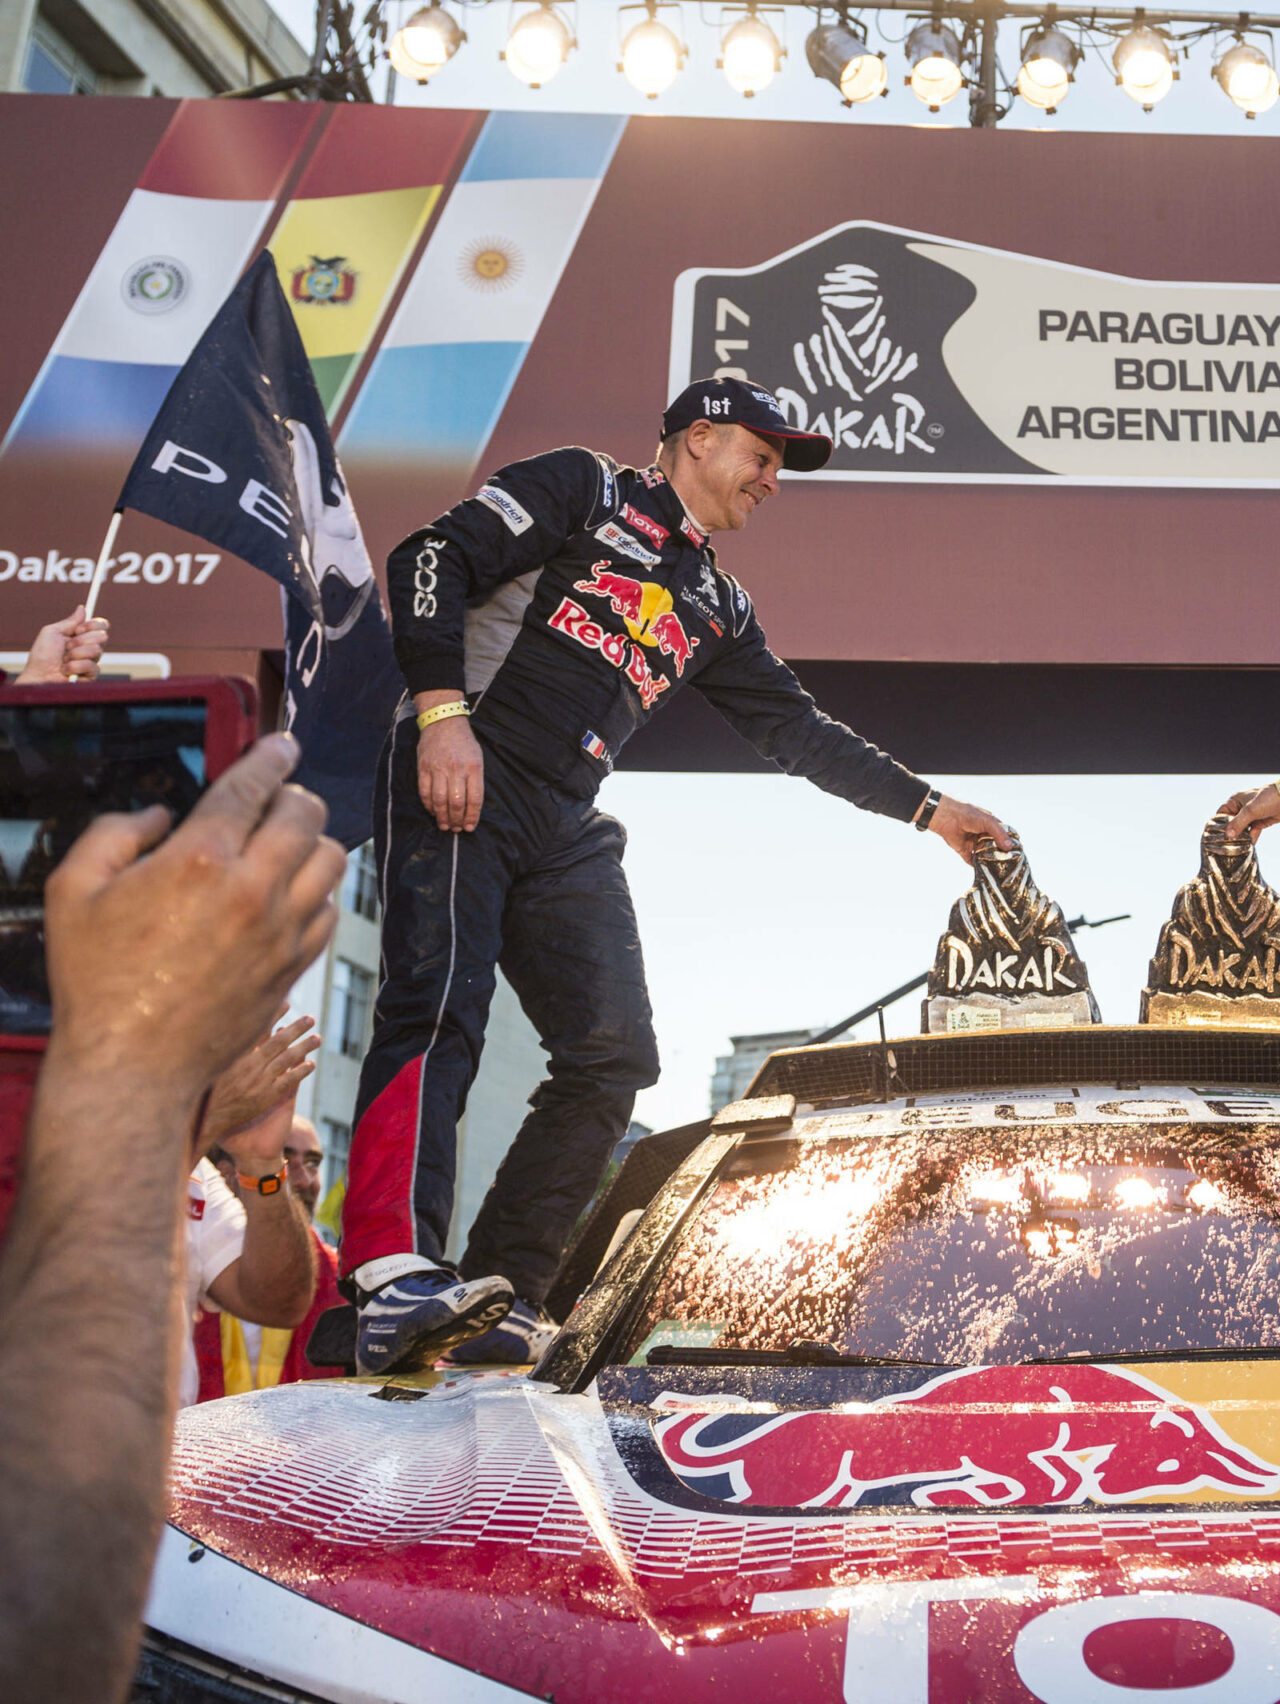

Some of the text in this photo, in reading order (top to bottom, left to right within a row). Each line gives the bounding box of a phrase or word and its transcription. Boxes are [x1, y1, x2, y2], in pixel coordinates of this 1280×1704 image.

[715, 297, 750, 378] 17
[702, 395, 732, 417] 1st
[775, 386, 936, 454] DAKAR
[547, 597, 629, 667] Red
[946, 935, 1078, 991] DAKAR
